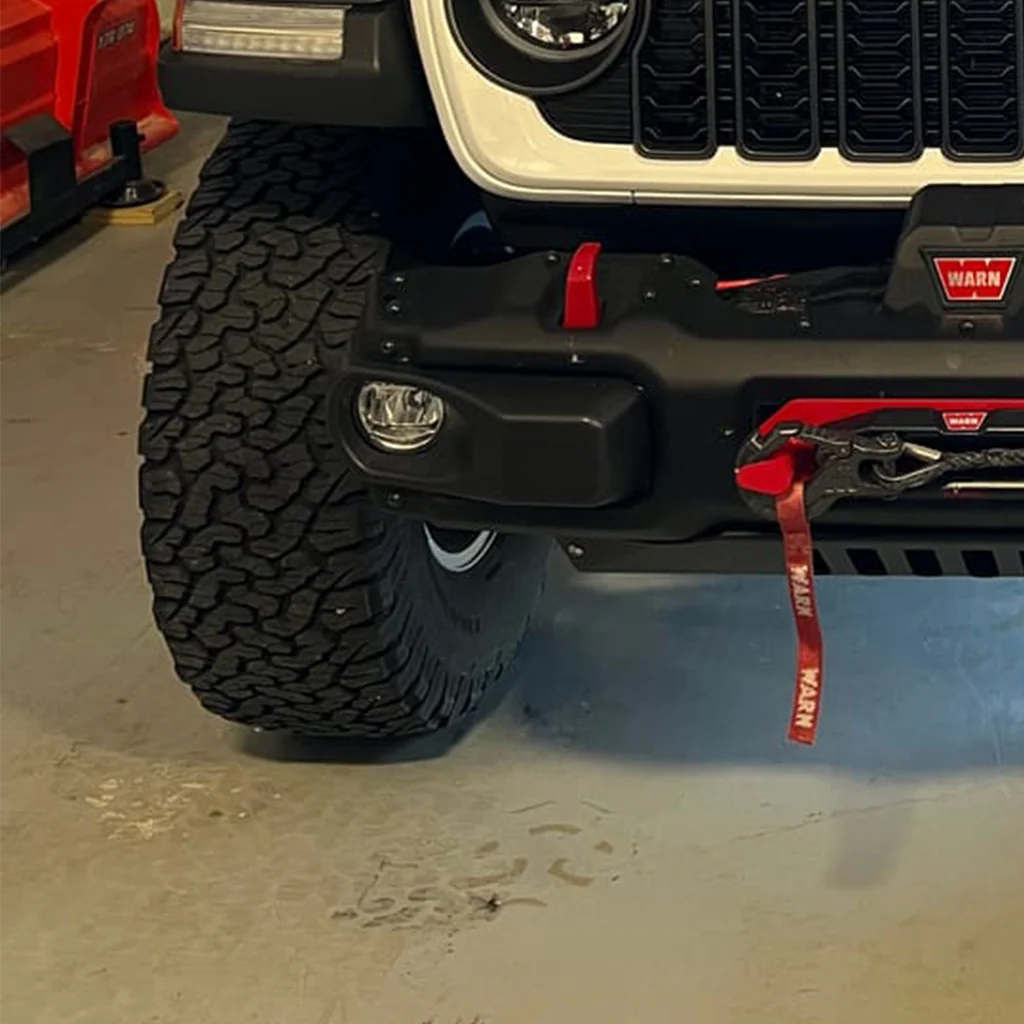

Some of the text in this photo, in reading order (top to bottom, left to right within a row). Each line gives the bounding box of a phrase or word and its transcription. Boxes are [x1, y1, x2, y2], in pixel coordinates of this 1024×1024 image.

[948, 271, 1001, 287] WARN
[790, 564, 819, 729] WARN WARN
